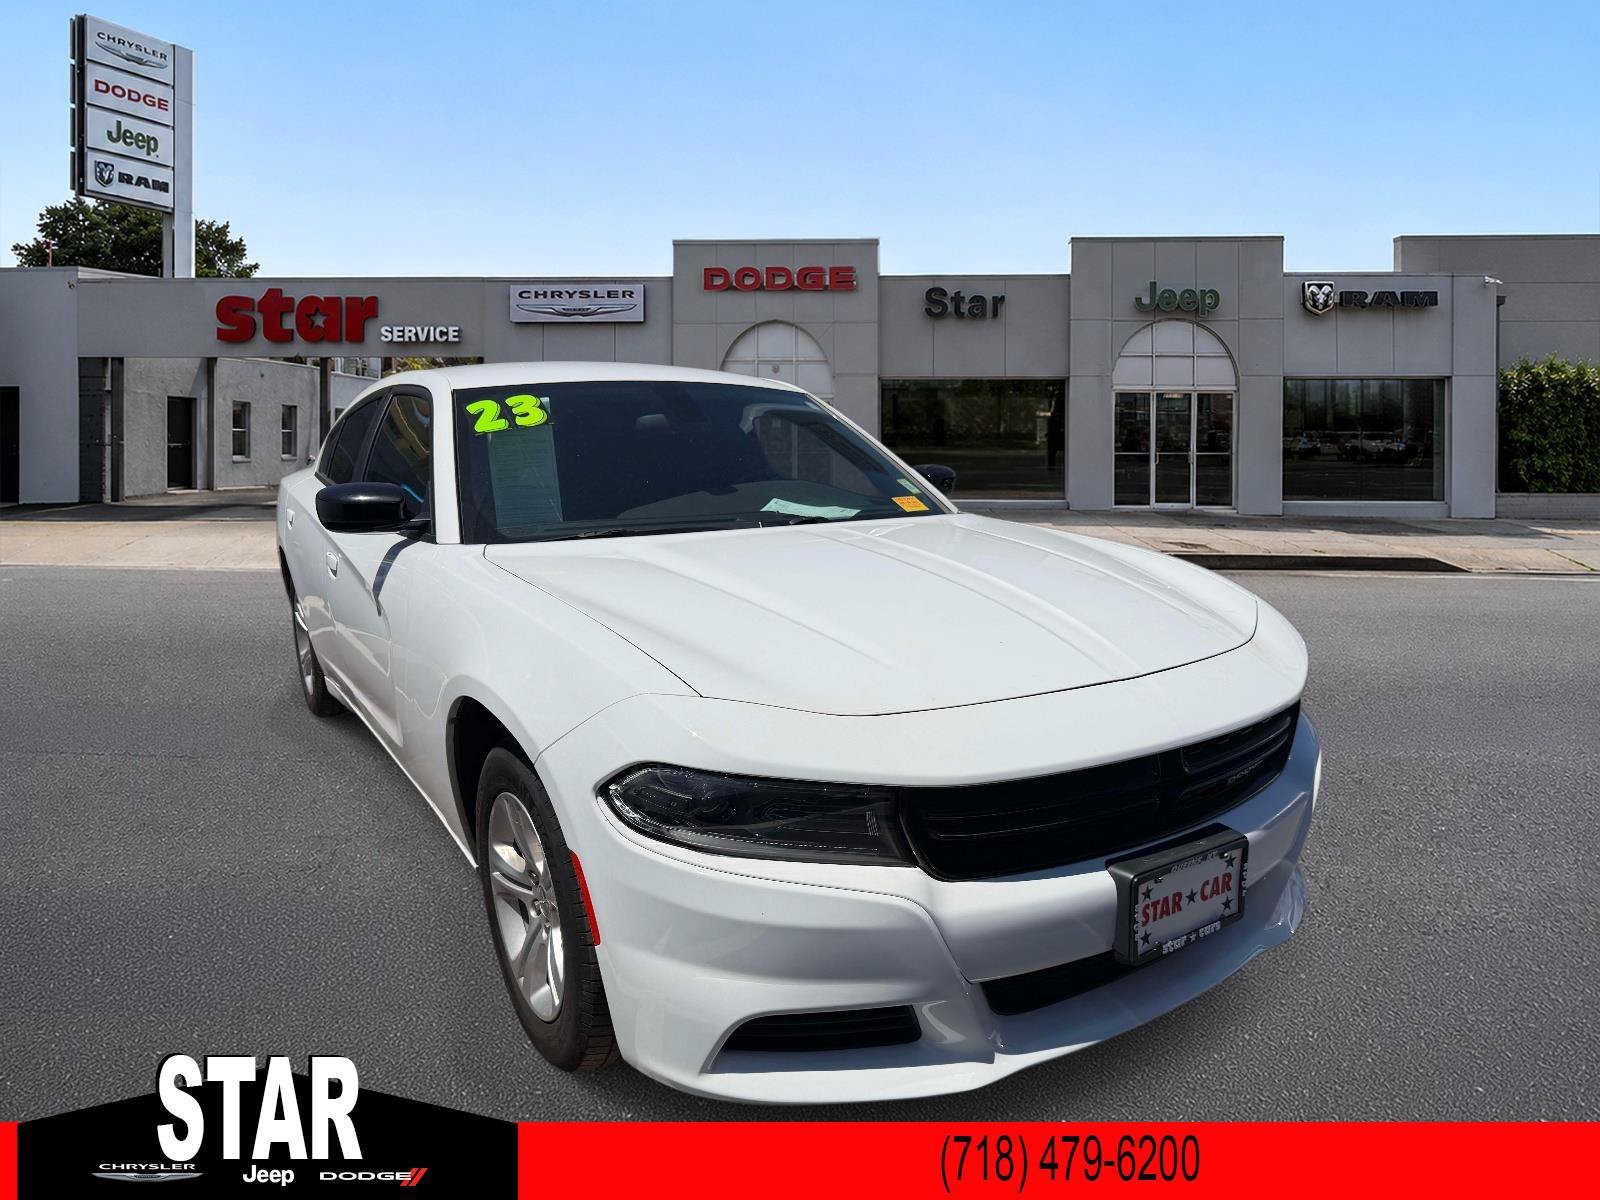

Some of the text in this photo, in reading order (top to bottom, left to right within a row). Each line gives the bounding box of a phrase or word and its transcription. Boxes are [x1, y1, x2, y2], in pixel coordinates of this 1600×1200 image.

[97, 32, 168, 61] CHRYSLER
[94, 79, 169, 111] DODGE
[107, 120, 159, 156] Jeep
[118, 171, 169, 193] RAM
[518, 290, 635, 299] CHRYSLER
[703, 266, 858, 292] DODGE
[924, 287, 1006, 319] Star
[1134, 280, 1221, 316] Jeep
[1338, 290, 1439, 307] RAM
[216, 288, 461, 343] star SERVICE
[465, 394, 549, 433] 23
[1141, 892, 1183, 927] STAR
[1200, 872, 1232, 902] CAR
